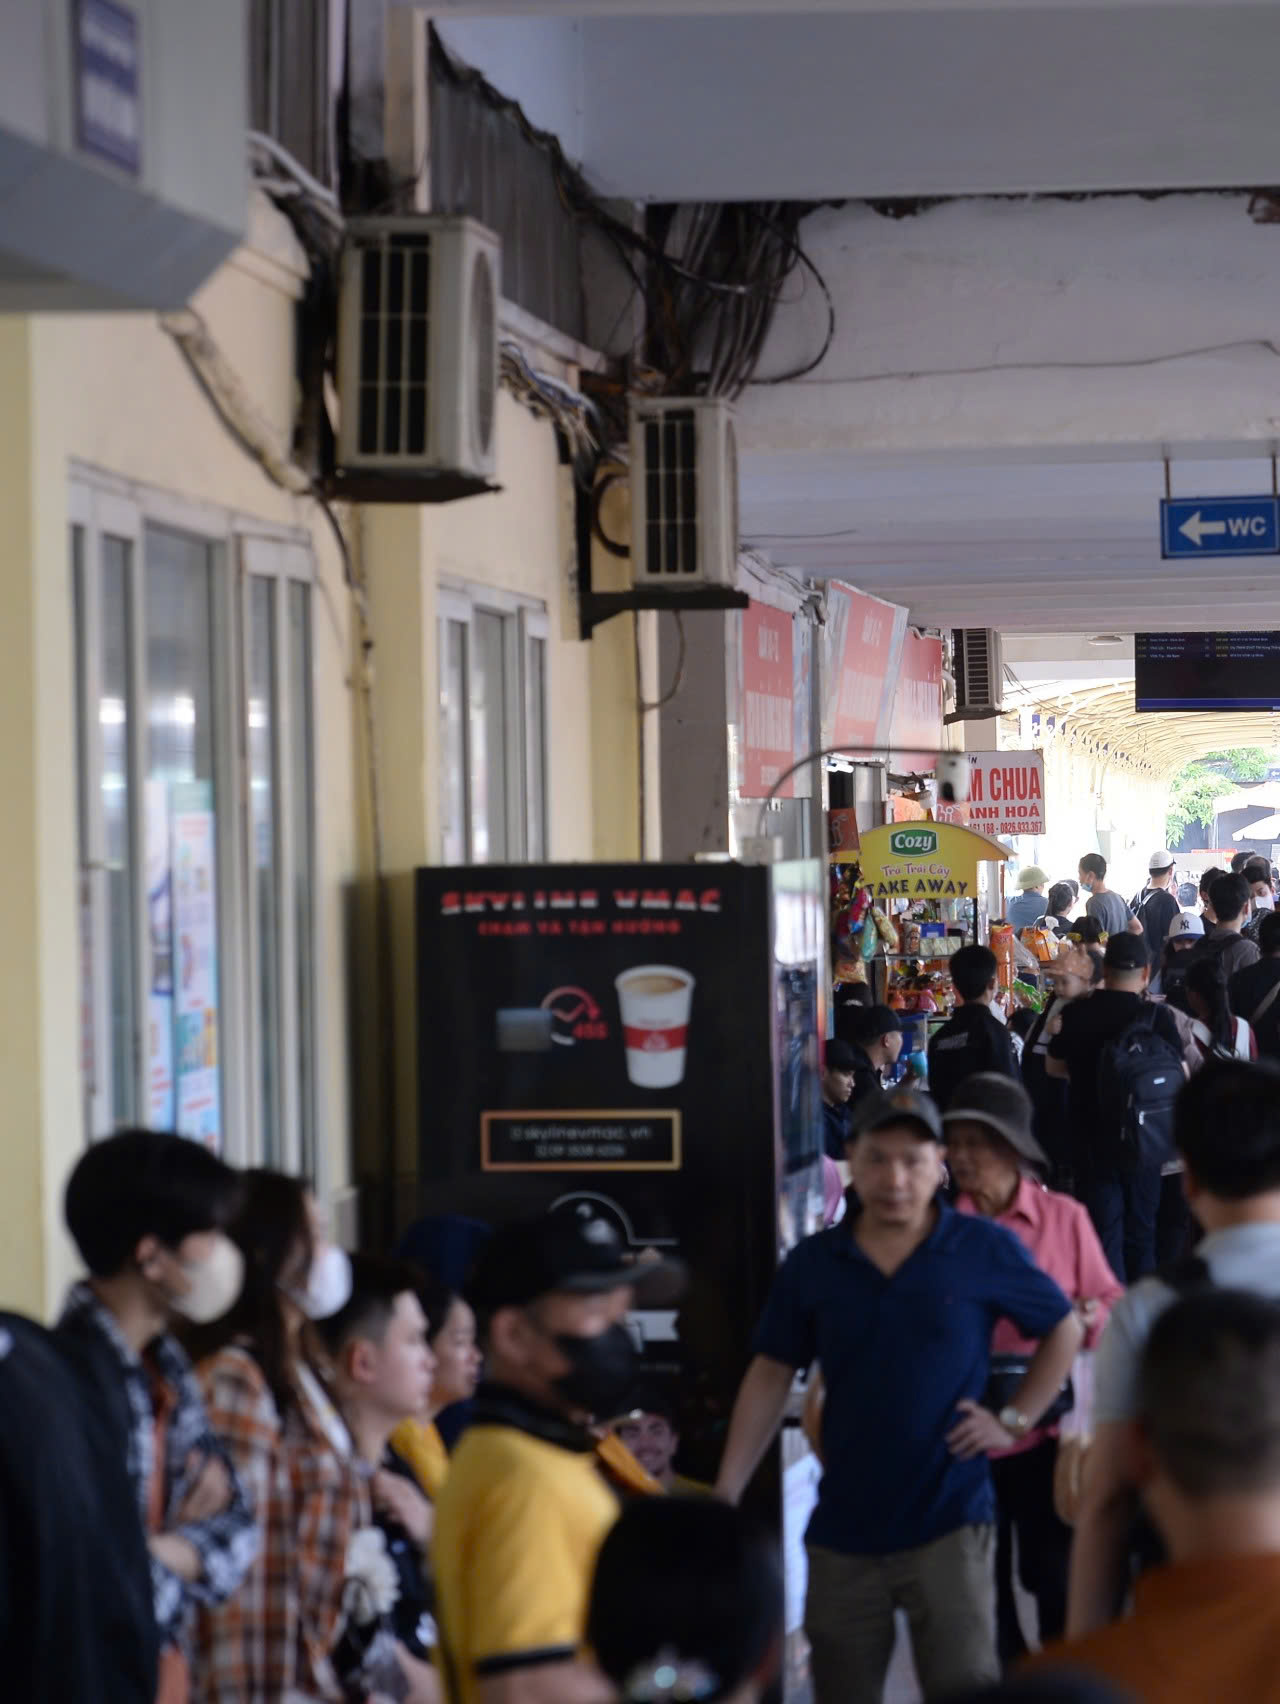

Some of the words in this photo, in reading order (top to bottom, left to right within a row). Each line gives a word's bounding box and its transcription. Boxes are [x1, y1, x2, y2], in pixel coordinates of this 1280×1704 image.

[1227, 517, 1266, 537] WC
[989, 767, 1041, 801] CHUA
[894, 834, 933, 851] Cozy
[865, 880, 909, 896] TAKE
[915, 879, 968, 895] AWAY
